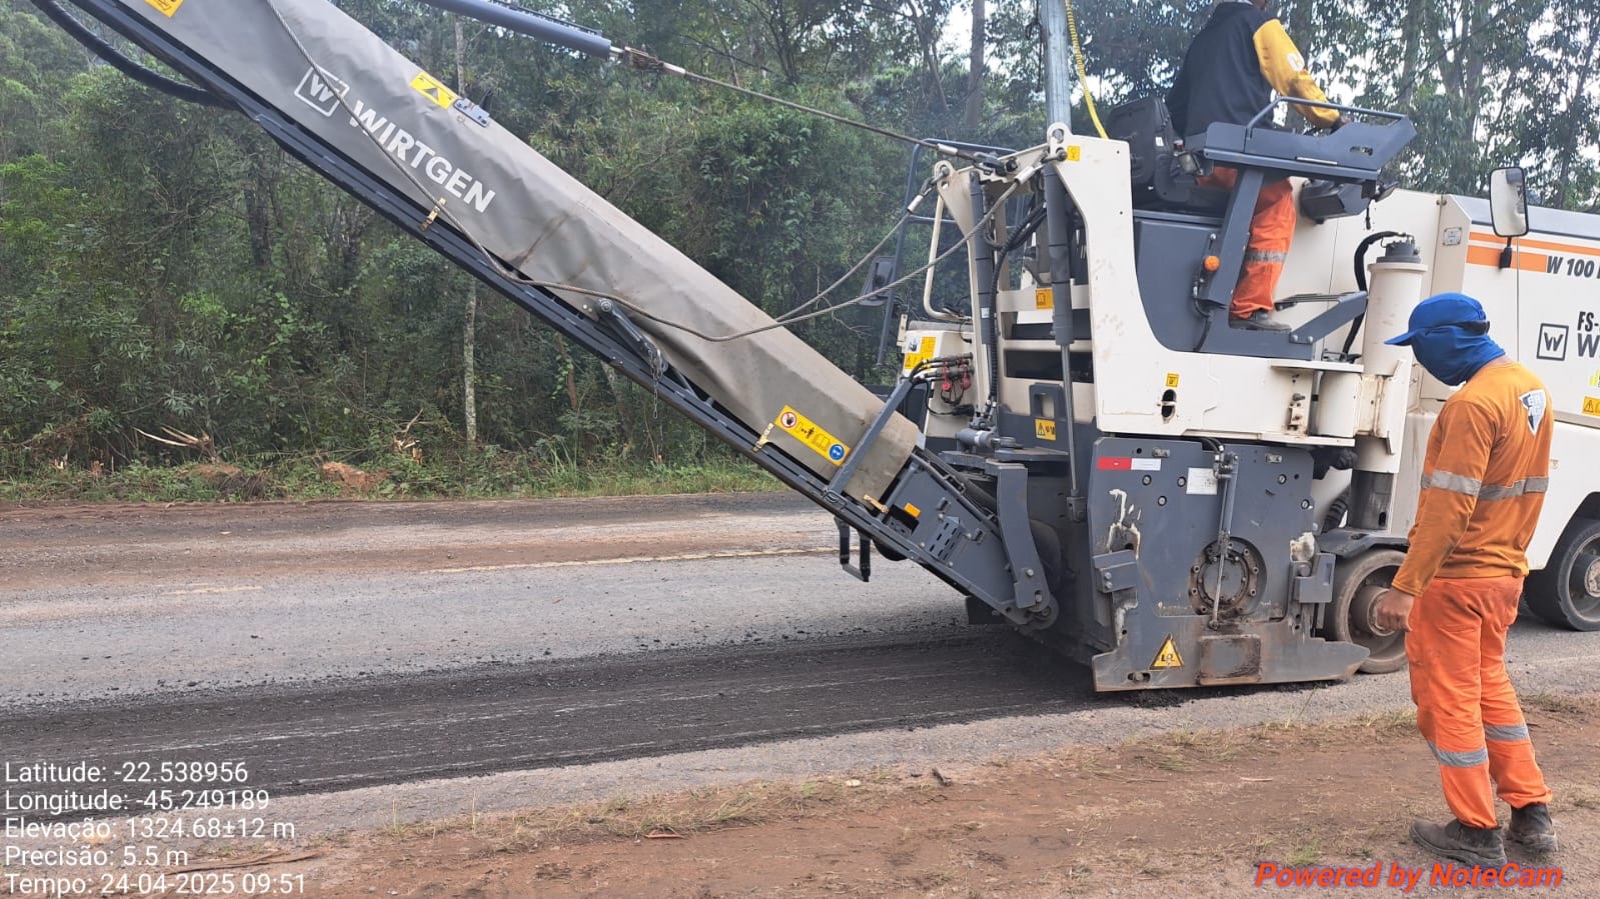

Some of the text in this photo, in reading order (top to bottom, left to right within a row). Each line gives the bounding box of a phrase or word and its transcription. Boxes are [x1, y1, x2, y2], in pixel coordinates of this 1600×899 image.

[349, 100, 496, 213] WIRTGEN
[1546, 255, 1564, 275] W
[1566, 258, 1595, 278] 100
[1577, 333, 1600, 358] W
